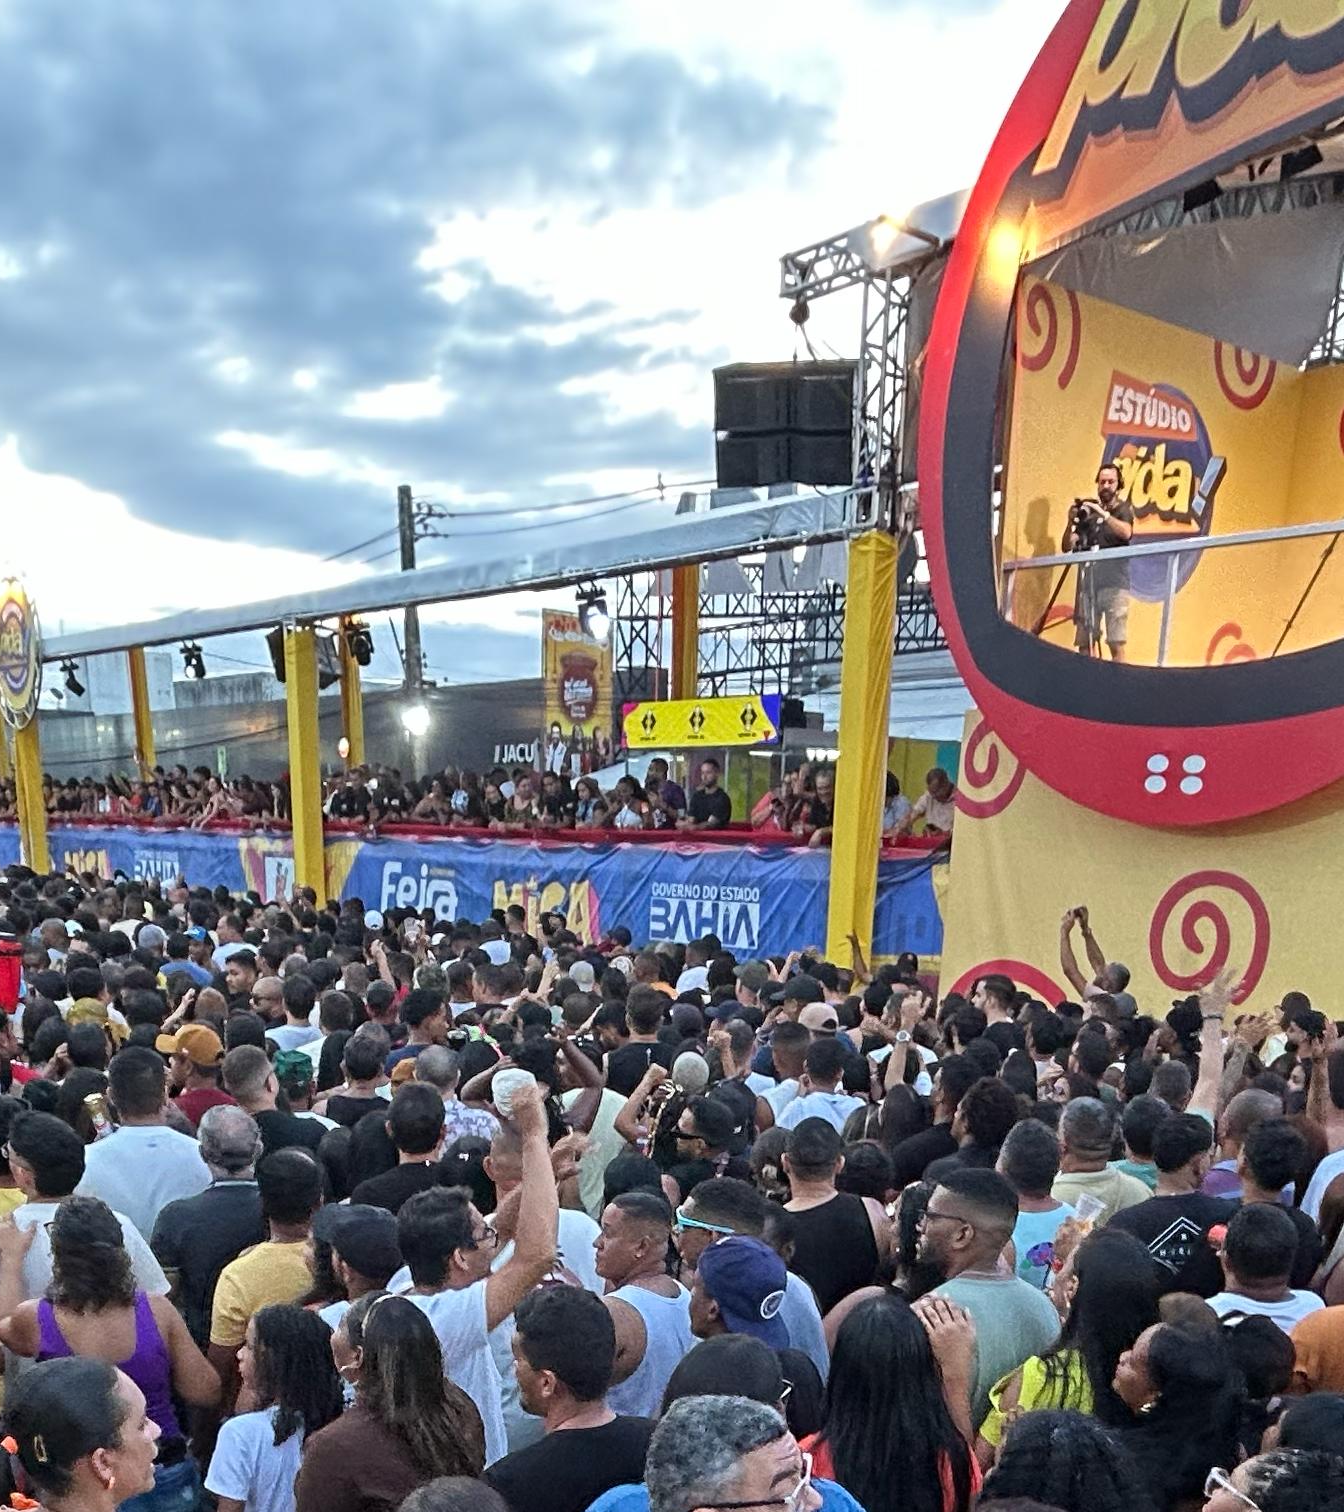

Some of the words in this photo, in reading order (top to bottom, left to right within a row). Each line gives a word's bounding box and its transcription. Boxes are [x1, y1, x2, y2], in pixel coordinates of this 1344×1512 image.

[1108, 384, 1192, 433] ESTÚDIO
[380, 861, 459, 922] Feira
[651, 882, 701, 899] GOVERNO
[702, 885, 718, 899] DO
[720, 886, 760, 902] ESTADO
[650, 898, 758, 947] BAHIA
